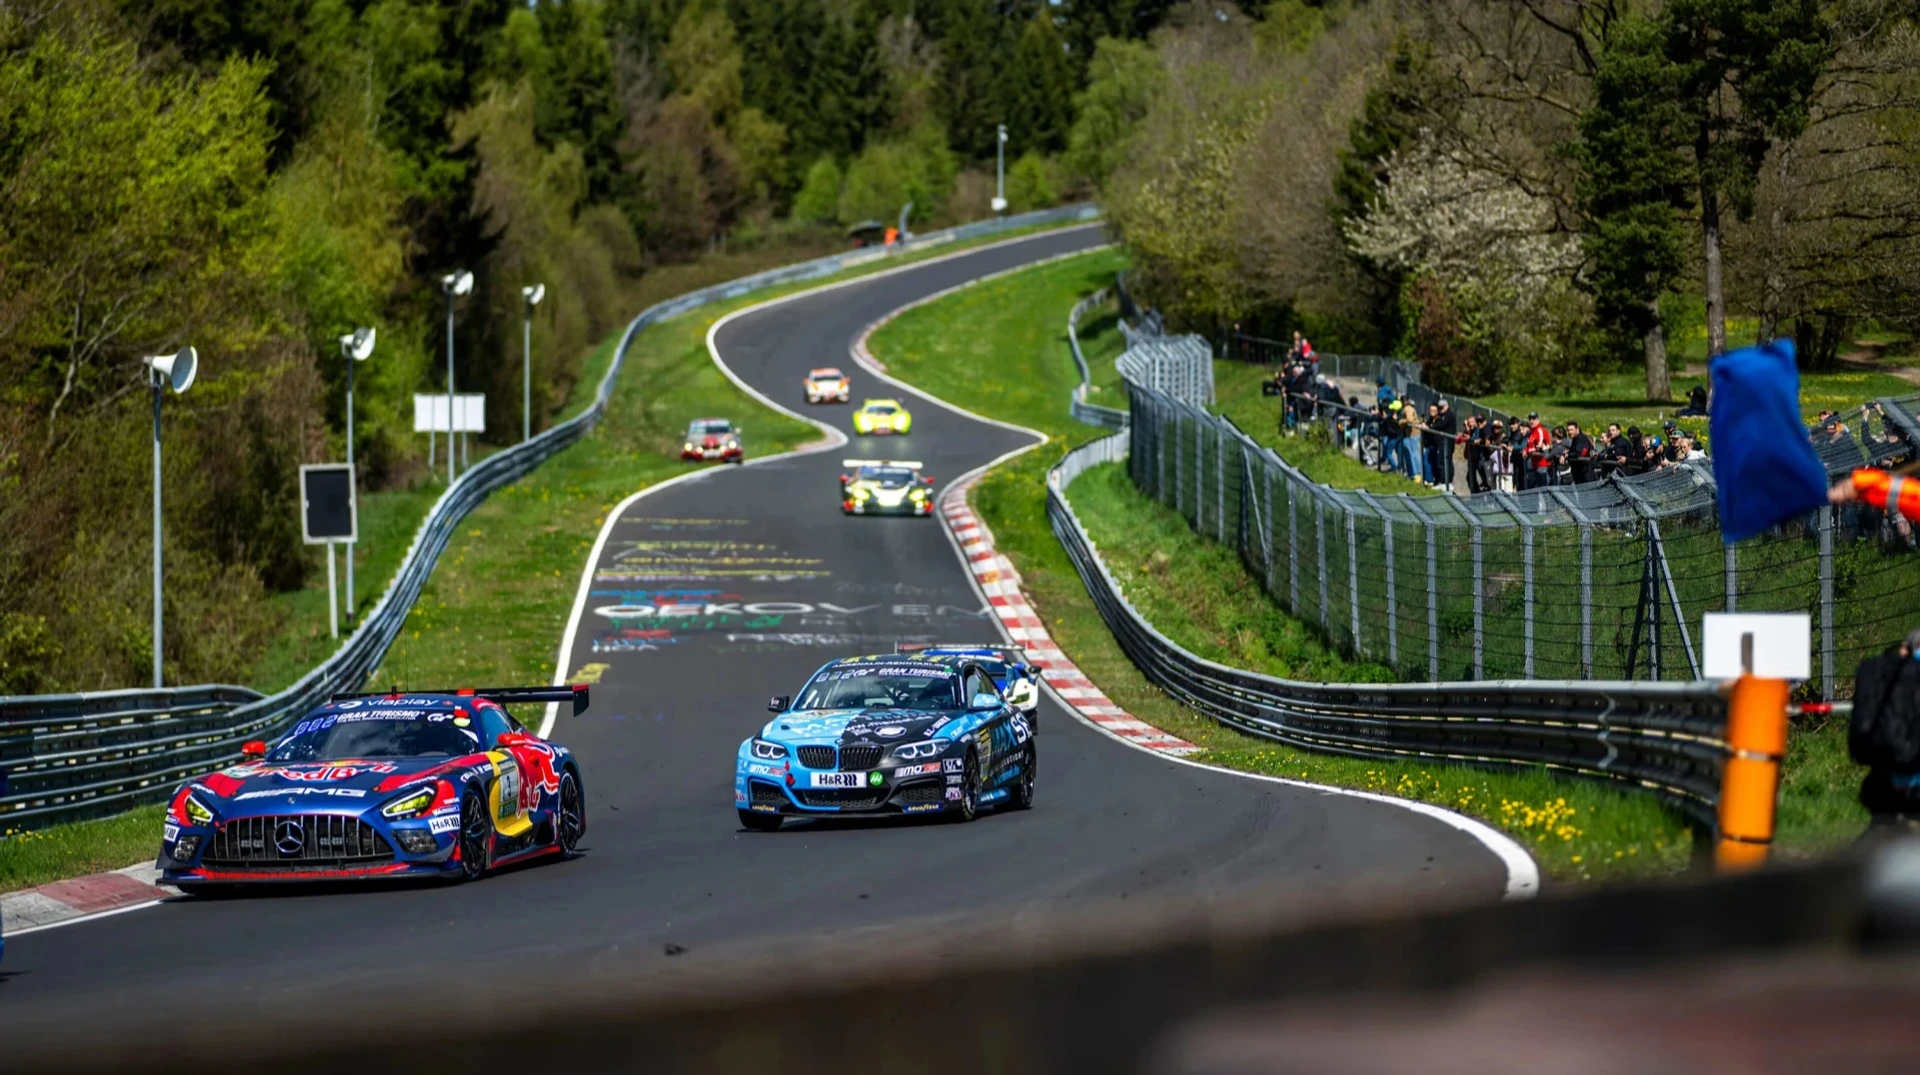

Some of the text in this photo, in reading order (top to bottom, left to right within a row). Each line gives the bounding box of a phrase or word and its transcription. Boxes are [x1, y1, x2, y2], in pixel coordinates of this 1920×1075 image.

[879, 667, 910, 676] GRAN
[912, 668, 952, 678] TURISMO
[368, 698, 440, 706] viaplay
[338, 710, 420, 720] GRAN TURISMO
[326, 764, 399, 780] Bll
[819, 774, 844, 785] H&R
[506, 775, 512, 797] 3
[278, 787, 367, 798] AMG
[431, 818, 451, 831] H&R
